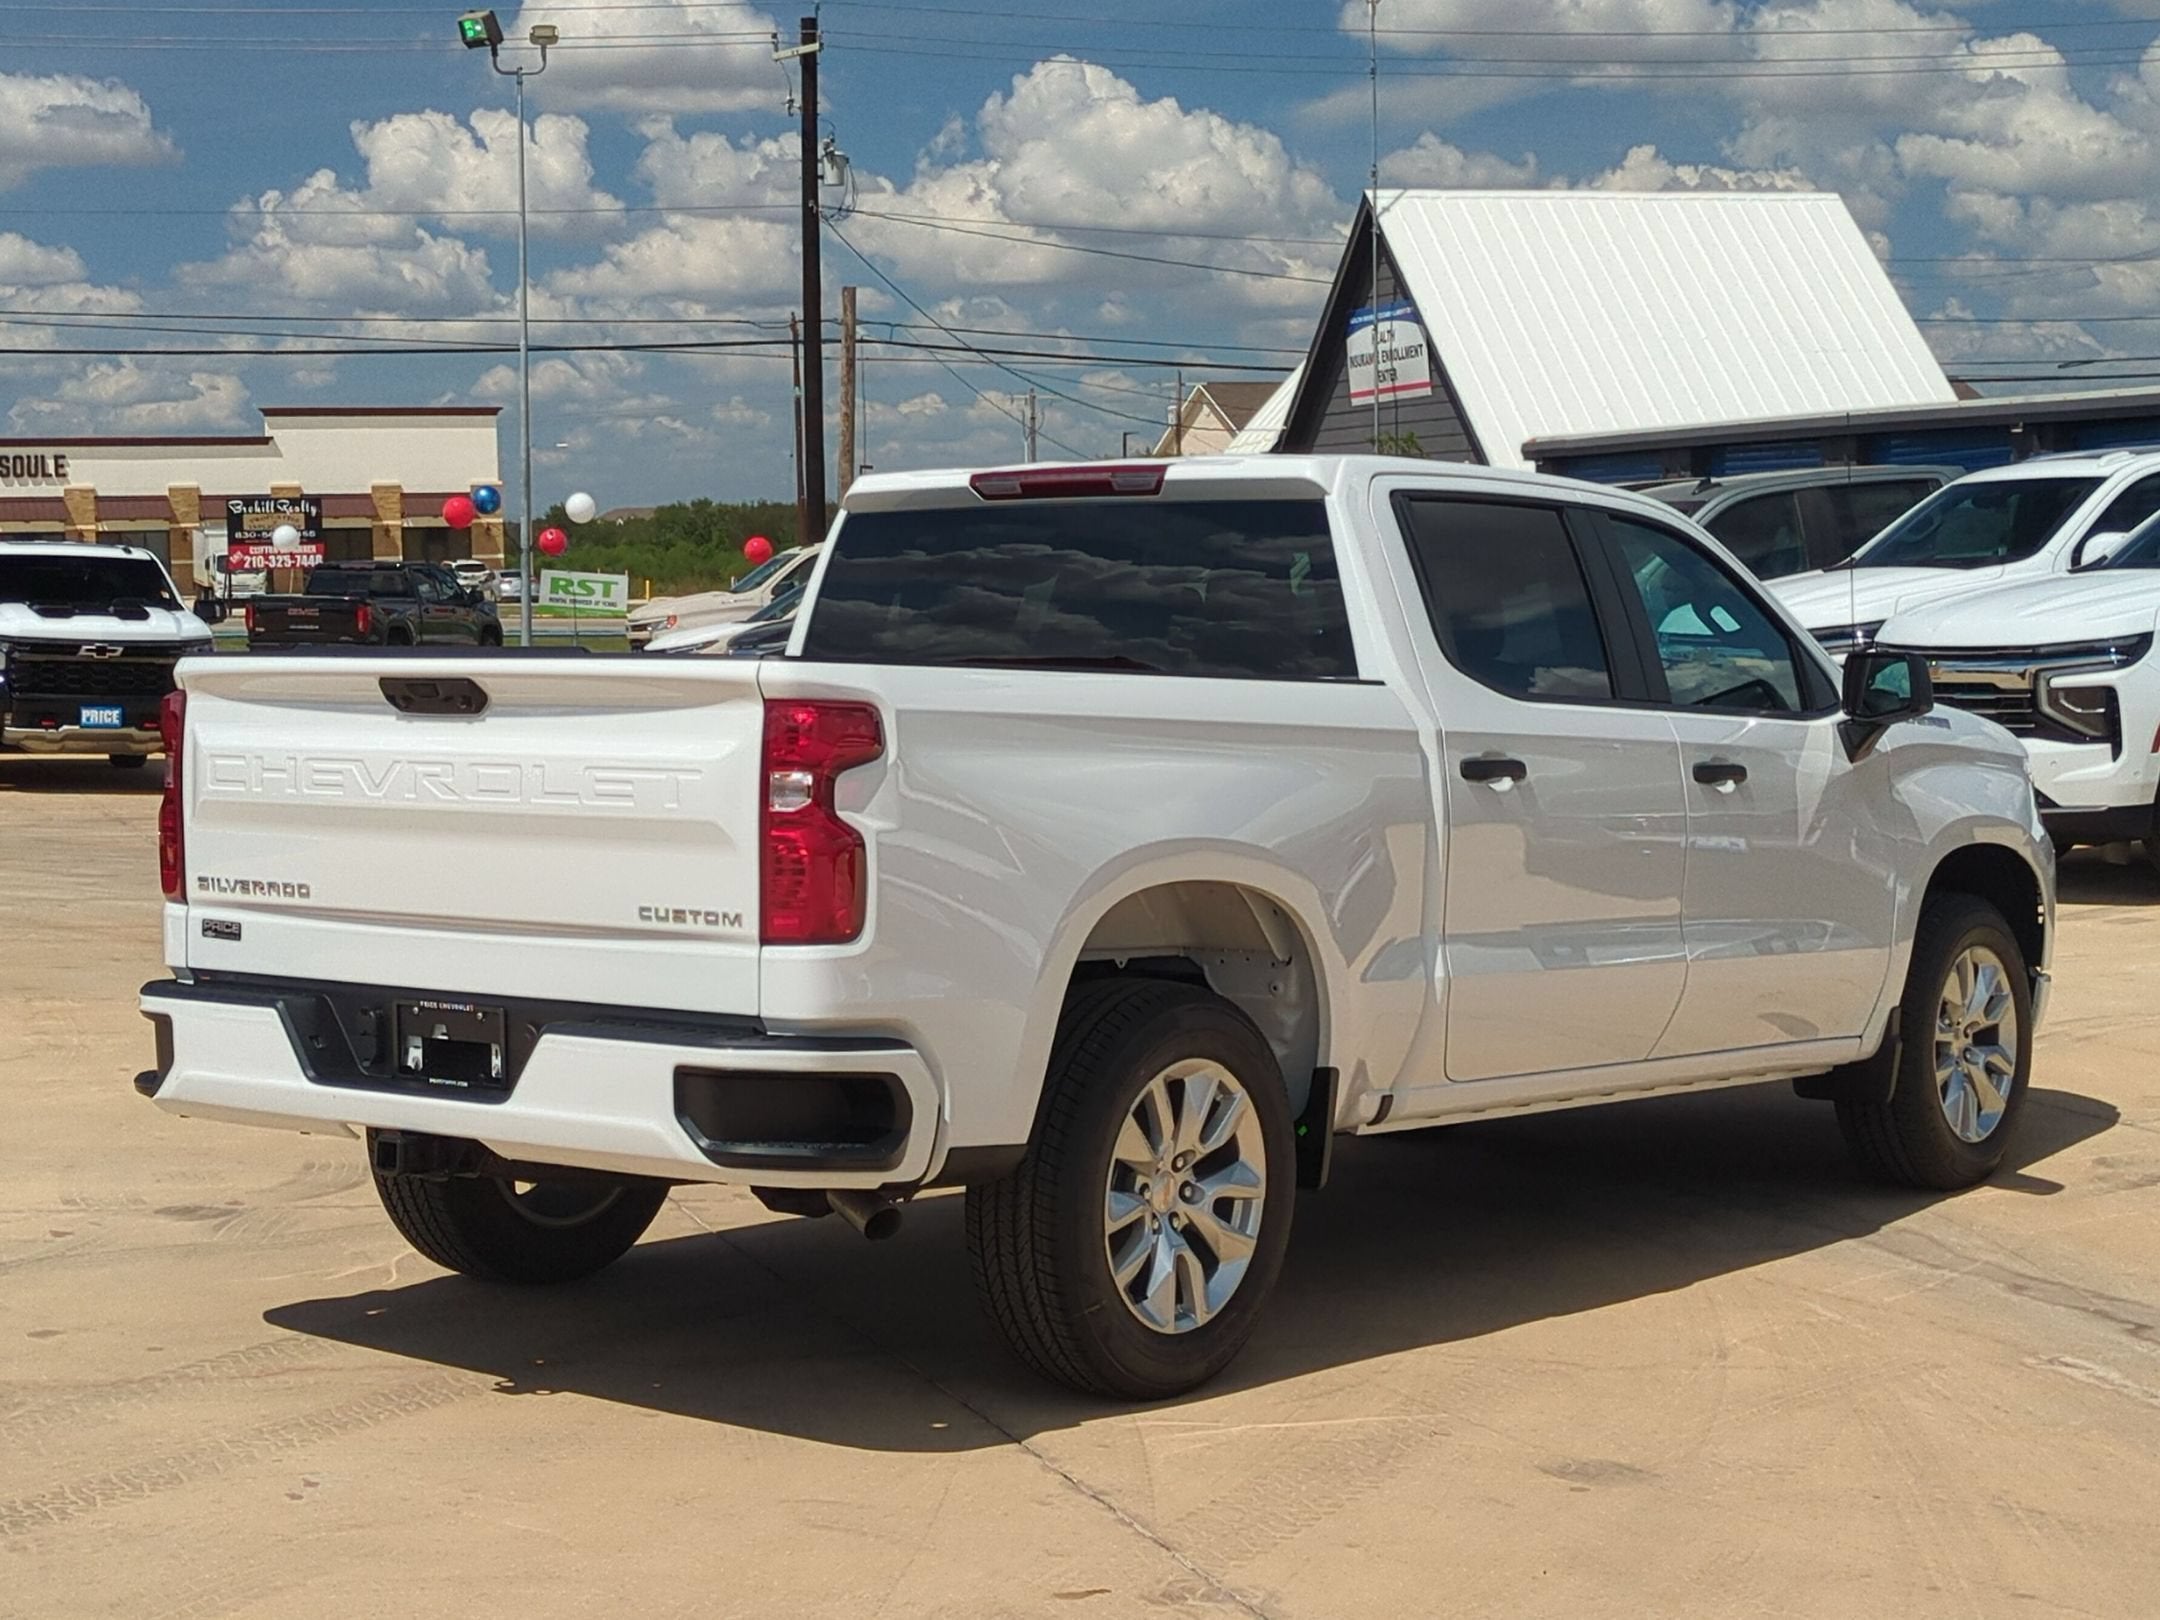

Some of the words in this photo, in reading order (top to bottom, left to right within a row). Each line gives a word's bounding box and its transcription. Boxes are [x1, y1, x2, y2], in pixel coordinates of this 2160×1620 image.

[1349, 351, 1380, 369] INSURANE
[1374, 367, 1398, 383] ENTER
[0, 454, 67, 478] SOULE
[550, 576, 619, 598] RST
[81, 708, 121, 725] PRICE
[207, 754, 703, 809] CHEVROLET
[197, 876, 311, 899] SILVERADO
[203, 920, 240, 933] PRICE
[638, 906, 743, 928] CUSTOM
